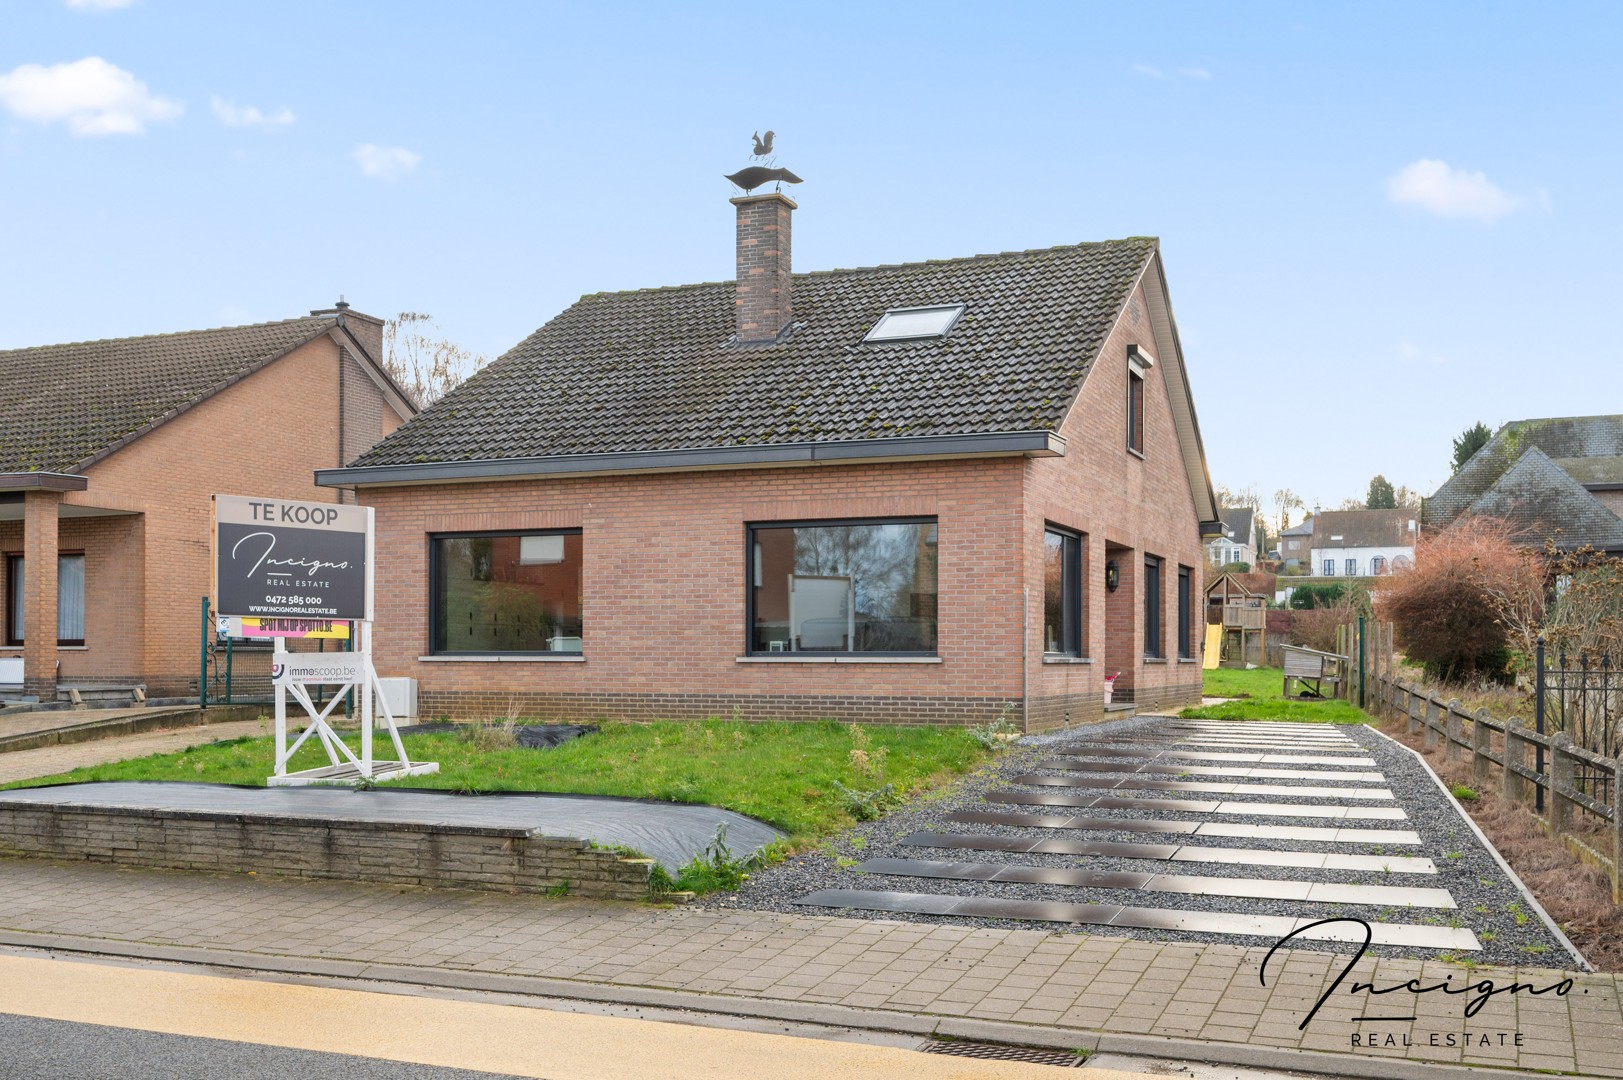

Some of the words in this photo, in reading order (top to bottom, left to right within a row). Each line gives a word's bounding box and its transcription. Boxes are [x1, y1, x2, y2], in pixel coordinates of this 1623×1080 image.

[249, 502, 275, 521] TE
[281, 505, 338, 525] KOOP
[266, 579, 290, 587] REAL
[295, 580, 330, 588] ESTATE
[265, 595, 287, 604] 0472
[288, 595, 304, 605] 585
[305, 597, 322, 605] 000
[248, 605, 338, 615] WWW.INCIGNOREALESTATE.BE
[259, 618, 276, 632] SPOT
[277, 618, 289, 632] MIJ
[290, 619, 299, 632] OP
[299, 619, 333, 633] SPOTTO.BE
[289, 666, 356, 677] immoscoop.be
